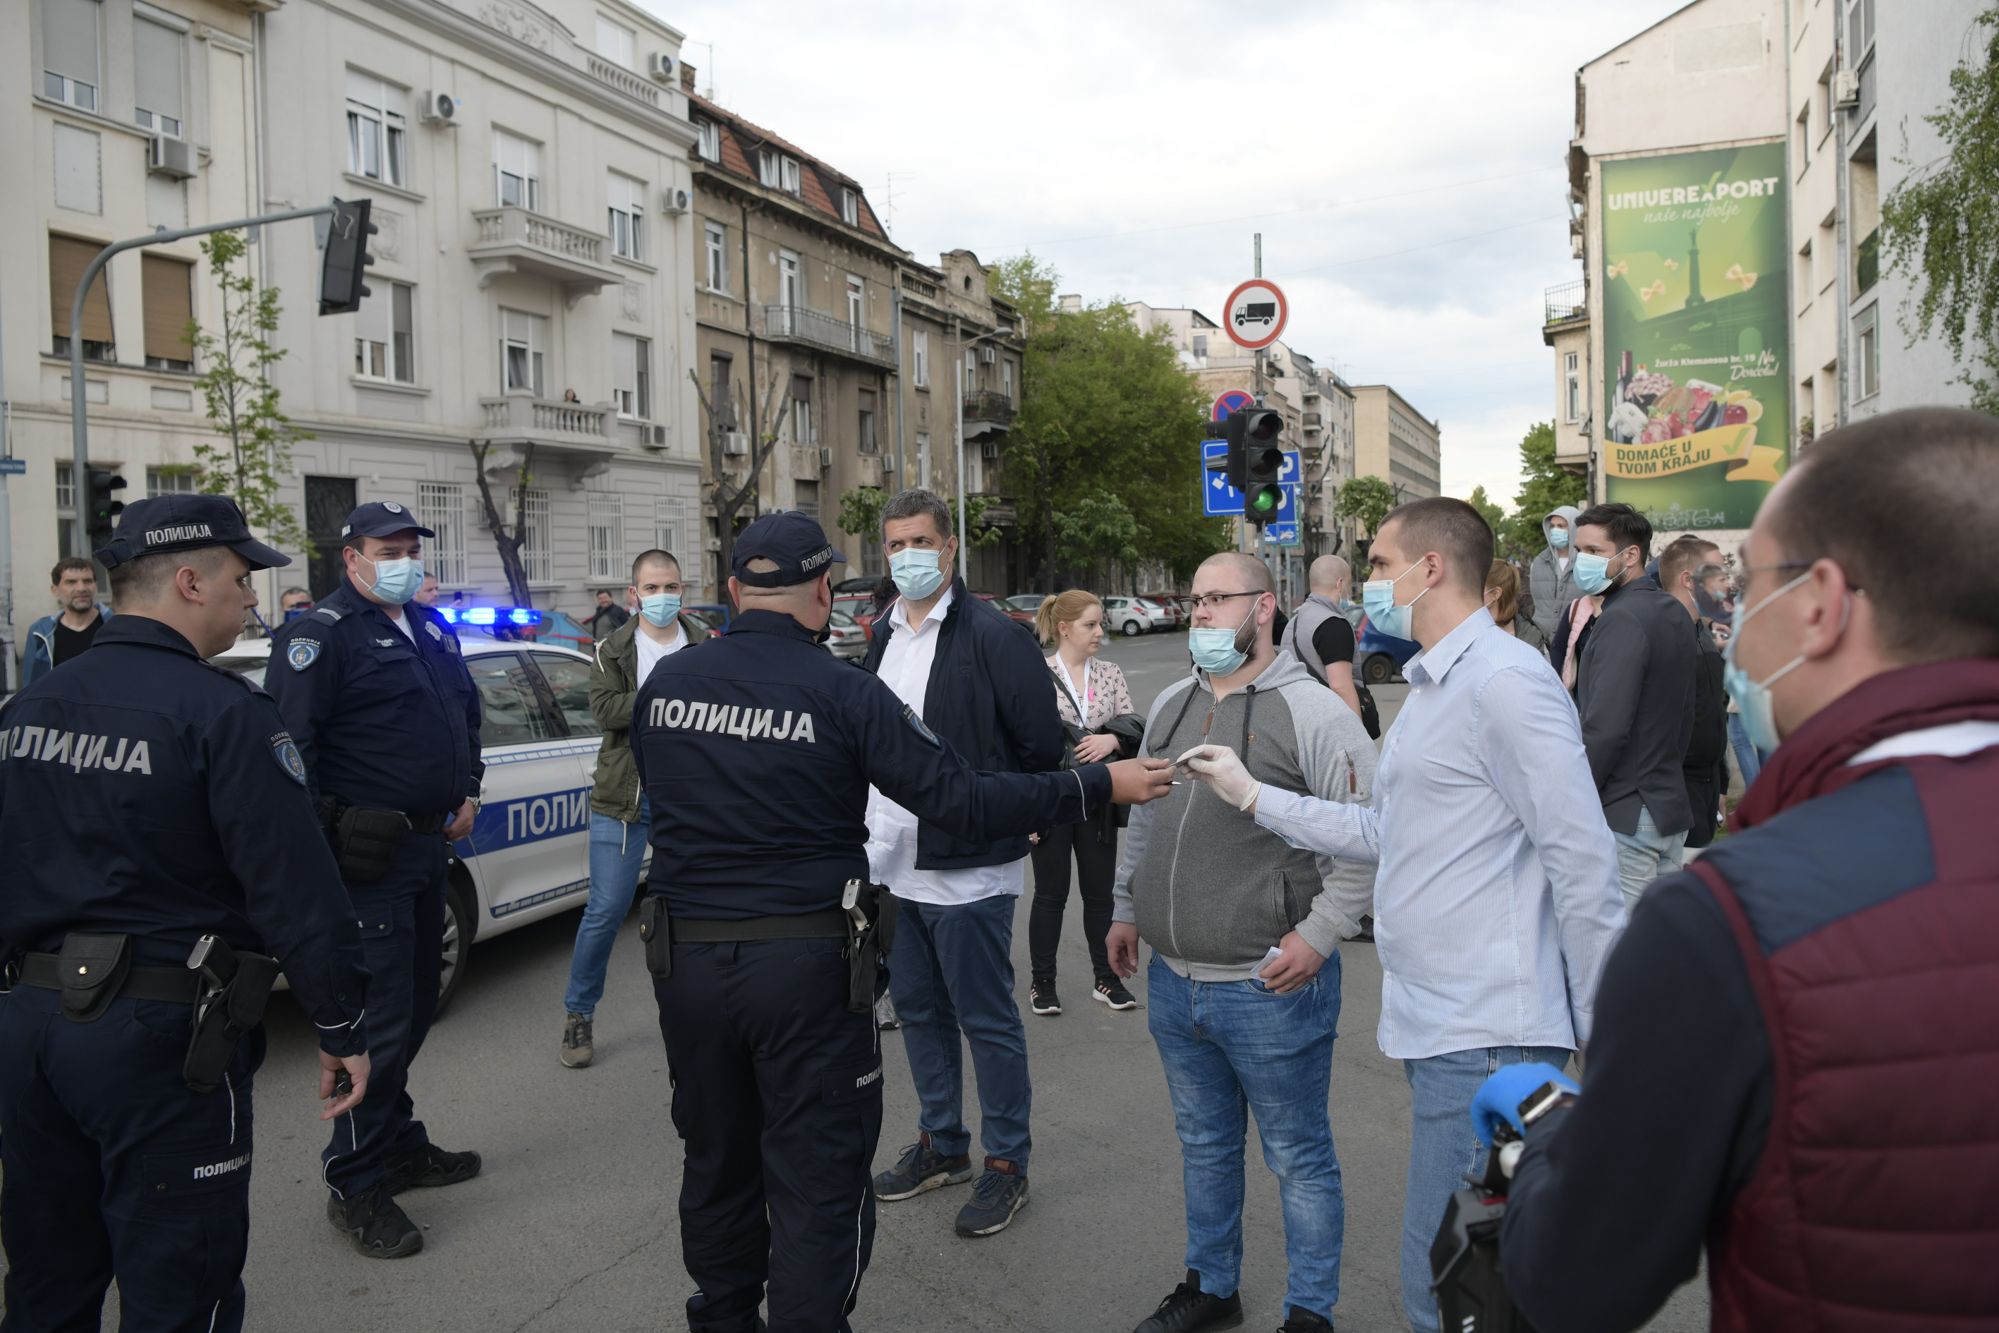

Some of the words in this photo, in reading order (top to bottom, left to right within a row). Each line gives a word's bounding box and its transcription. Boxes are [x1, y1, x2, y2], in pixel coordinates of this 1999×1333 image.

[1608, 173, 1779, 210] UNIVEREXPORT
[1681, 200, 1741, 225] najbolje
[1616, 444, 1678, 462] DOMAĆE
[1682, 440, 1692, 453] U
[1616, 461, 1657, 475] TVOM
[1662, 448, 1711, 471] KRAJU
[145, 524, 212, 545] ПОЛИЦИЈА
[649, 697, 816, 744] ПОЛИЦИЈА
